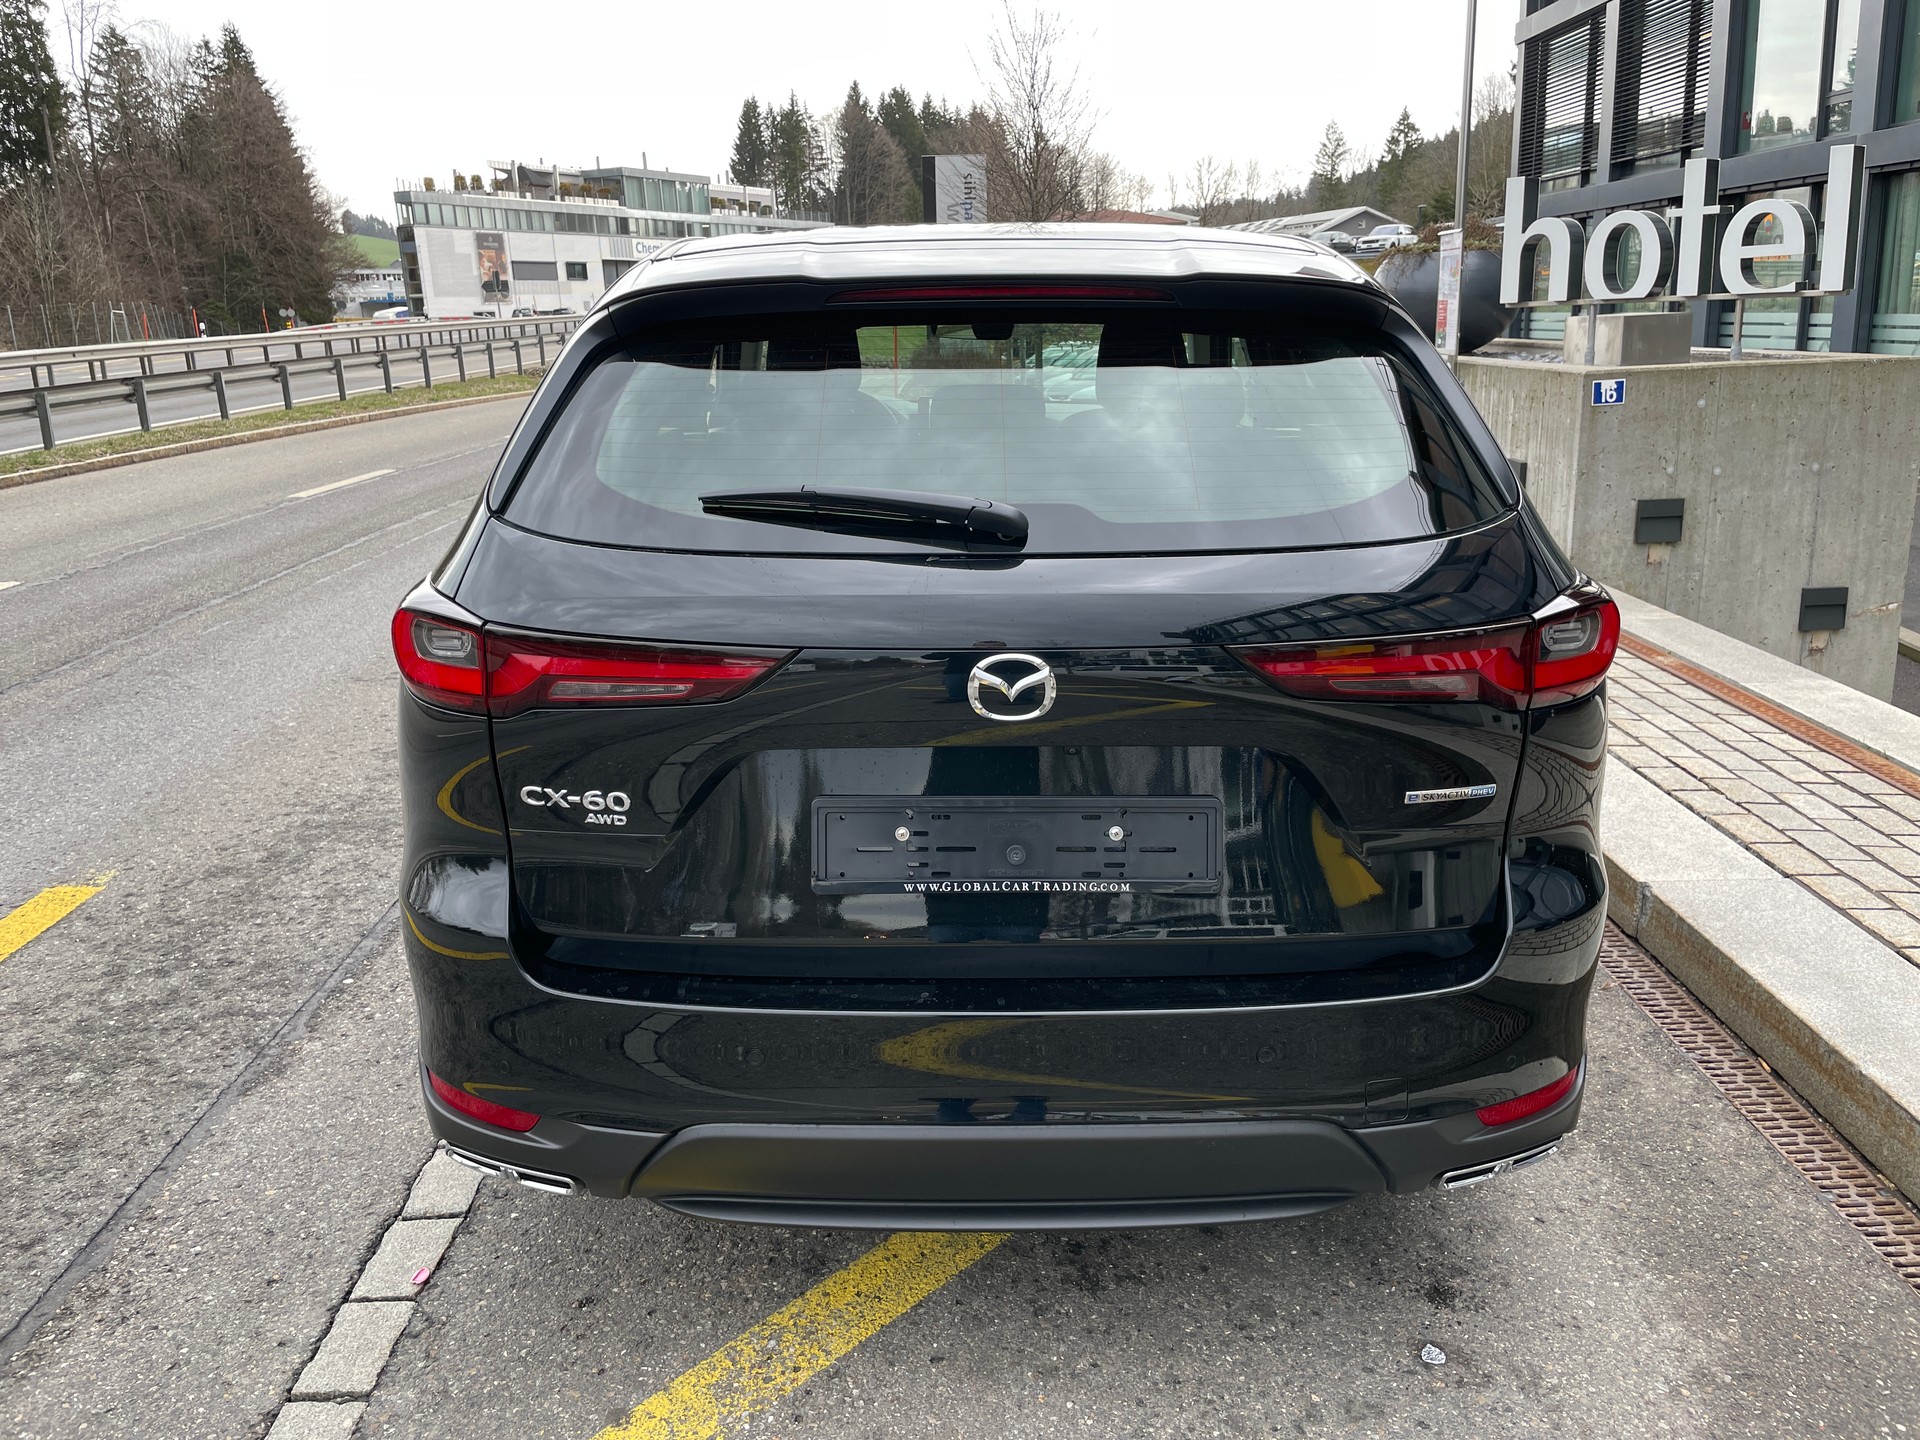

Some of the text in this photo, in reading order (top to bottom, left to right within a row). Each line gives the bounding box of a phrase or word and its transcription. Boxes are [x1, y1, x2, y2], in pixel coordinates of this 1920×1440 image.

[1500, 144, 1864, 304] hotel
[1600, 382, 1617, 403] 16
[520, 785, 631, 812] CX-60
[1422, 790, 1470, 801] SKYACTIV
[1472, 788, 1494, 797] PHEV
[585, 813, 627, 826] AWD
